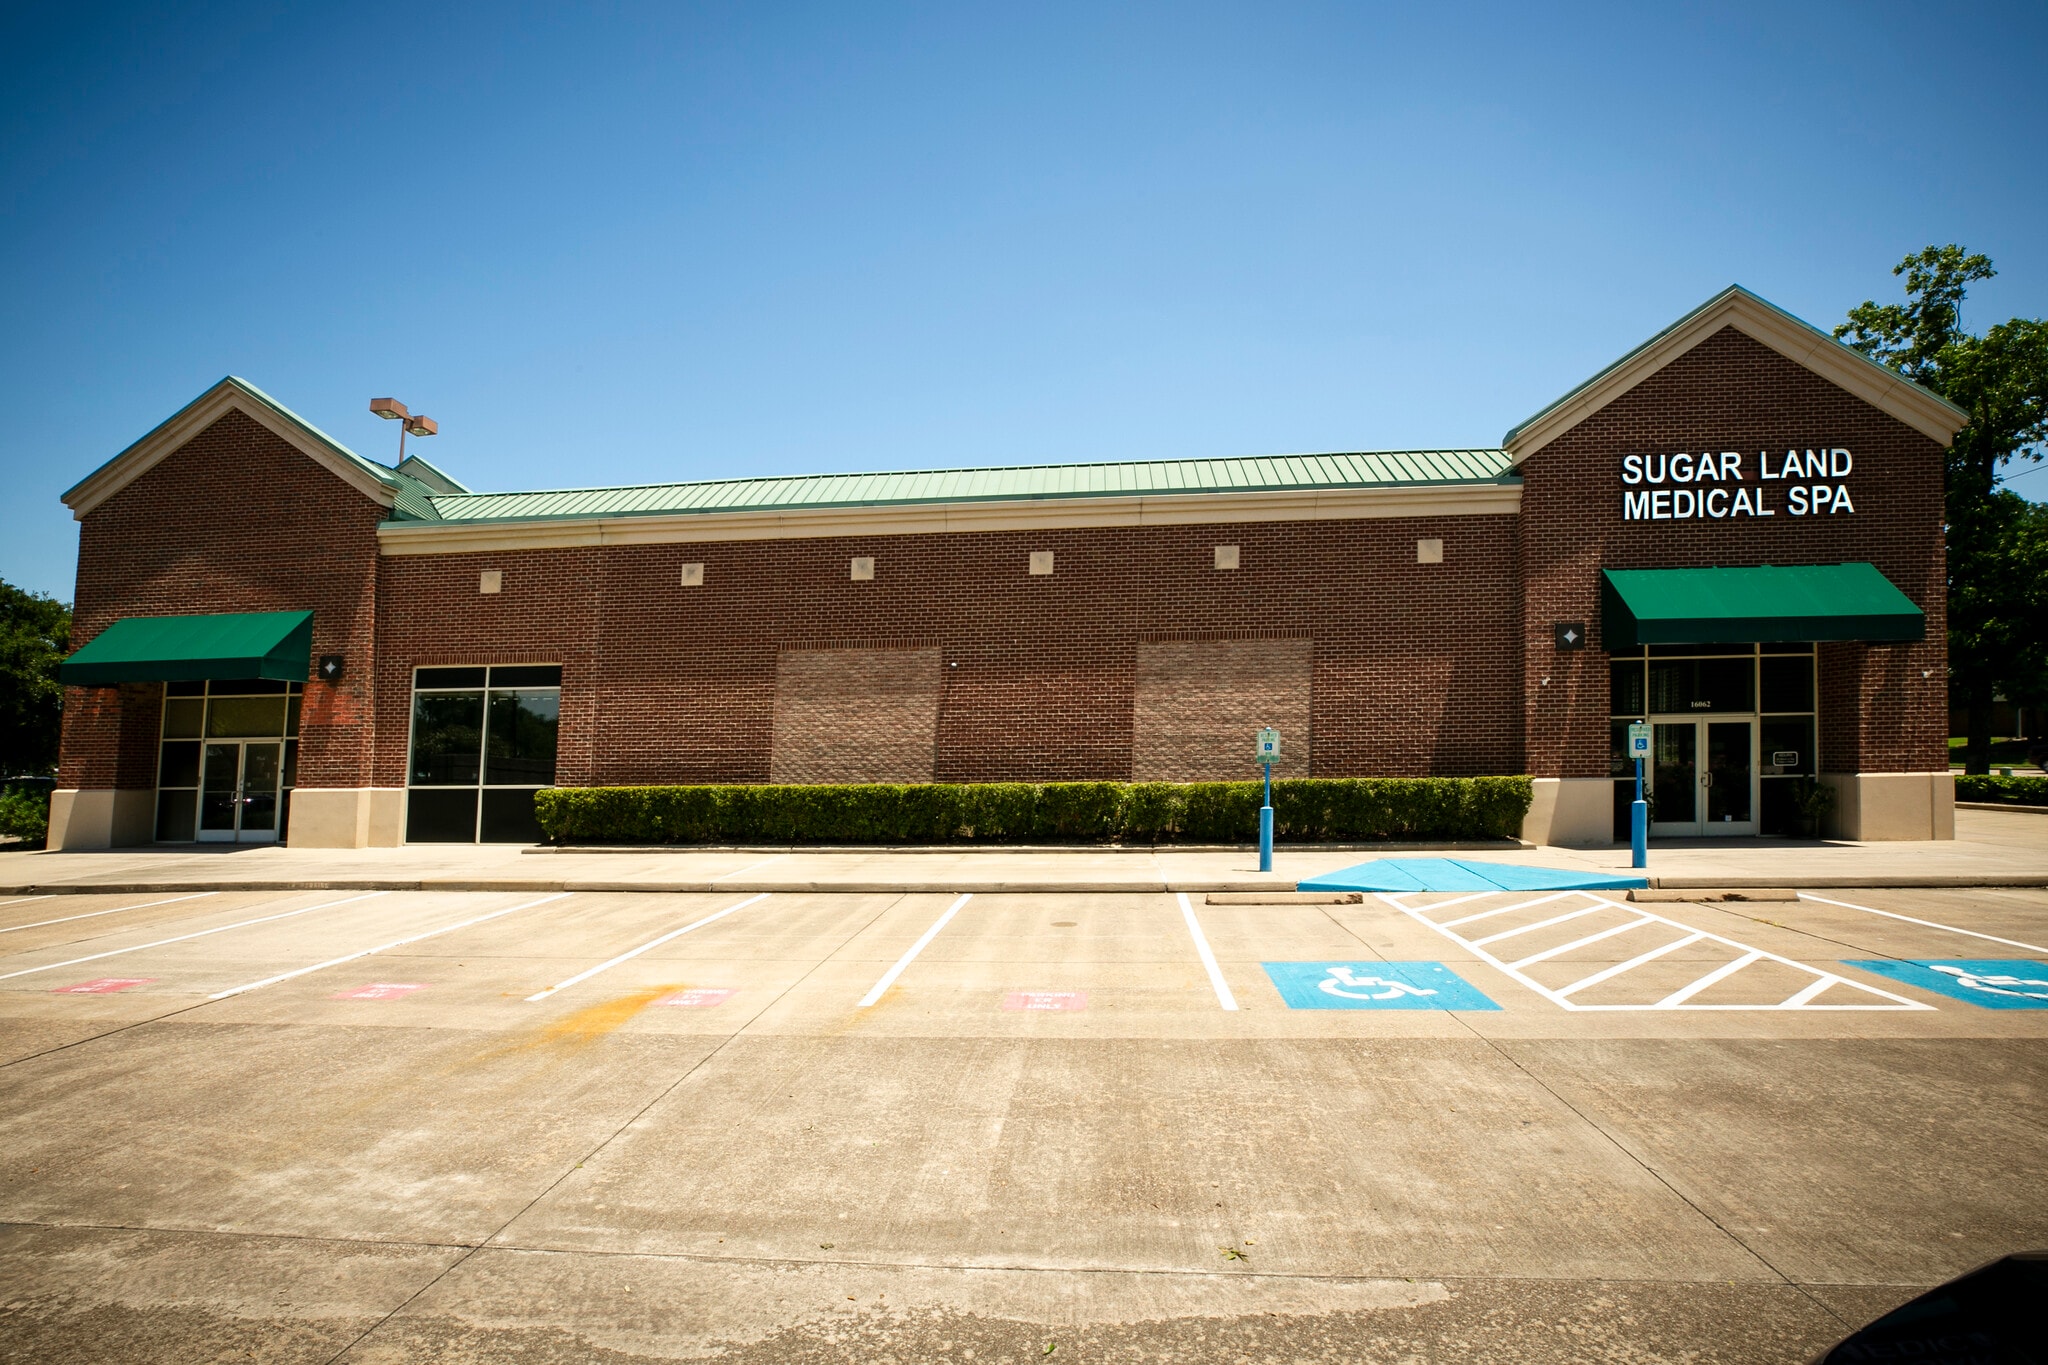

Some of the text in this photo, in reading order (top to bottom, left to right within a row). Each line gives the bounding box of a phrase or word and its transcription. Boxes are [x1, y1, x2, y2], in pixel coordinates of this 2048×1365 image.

[1621, 448, 1853, 484] SUGAR LAND
[1623, 484, 1855, 520] MEDICAL SPA
[1690, 700, 1712, 708] 16062
